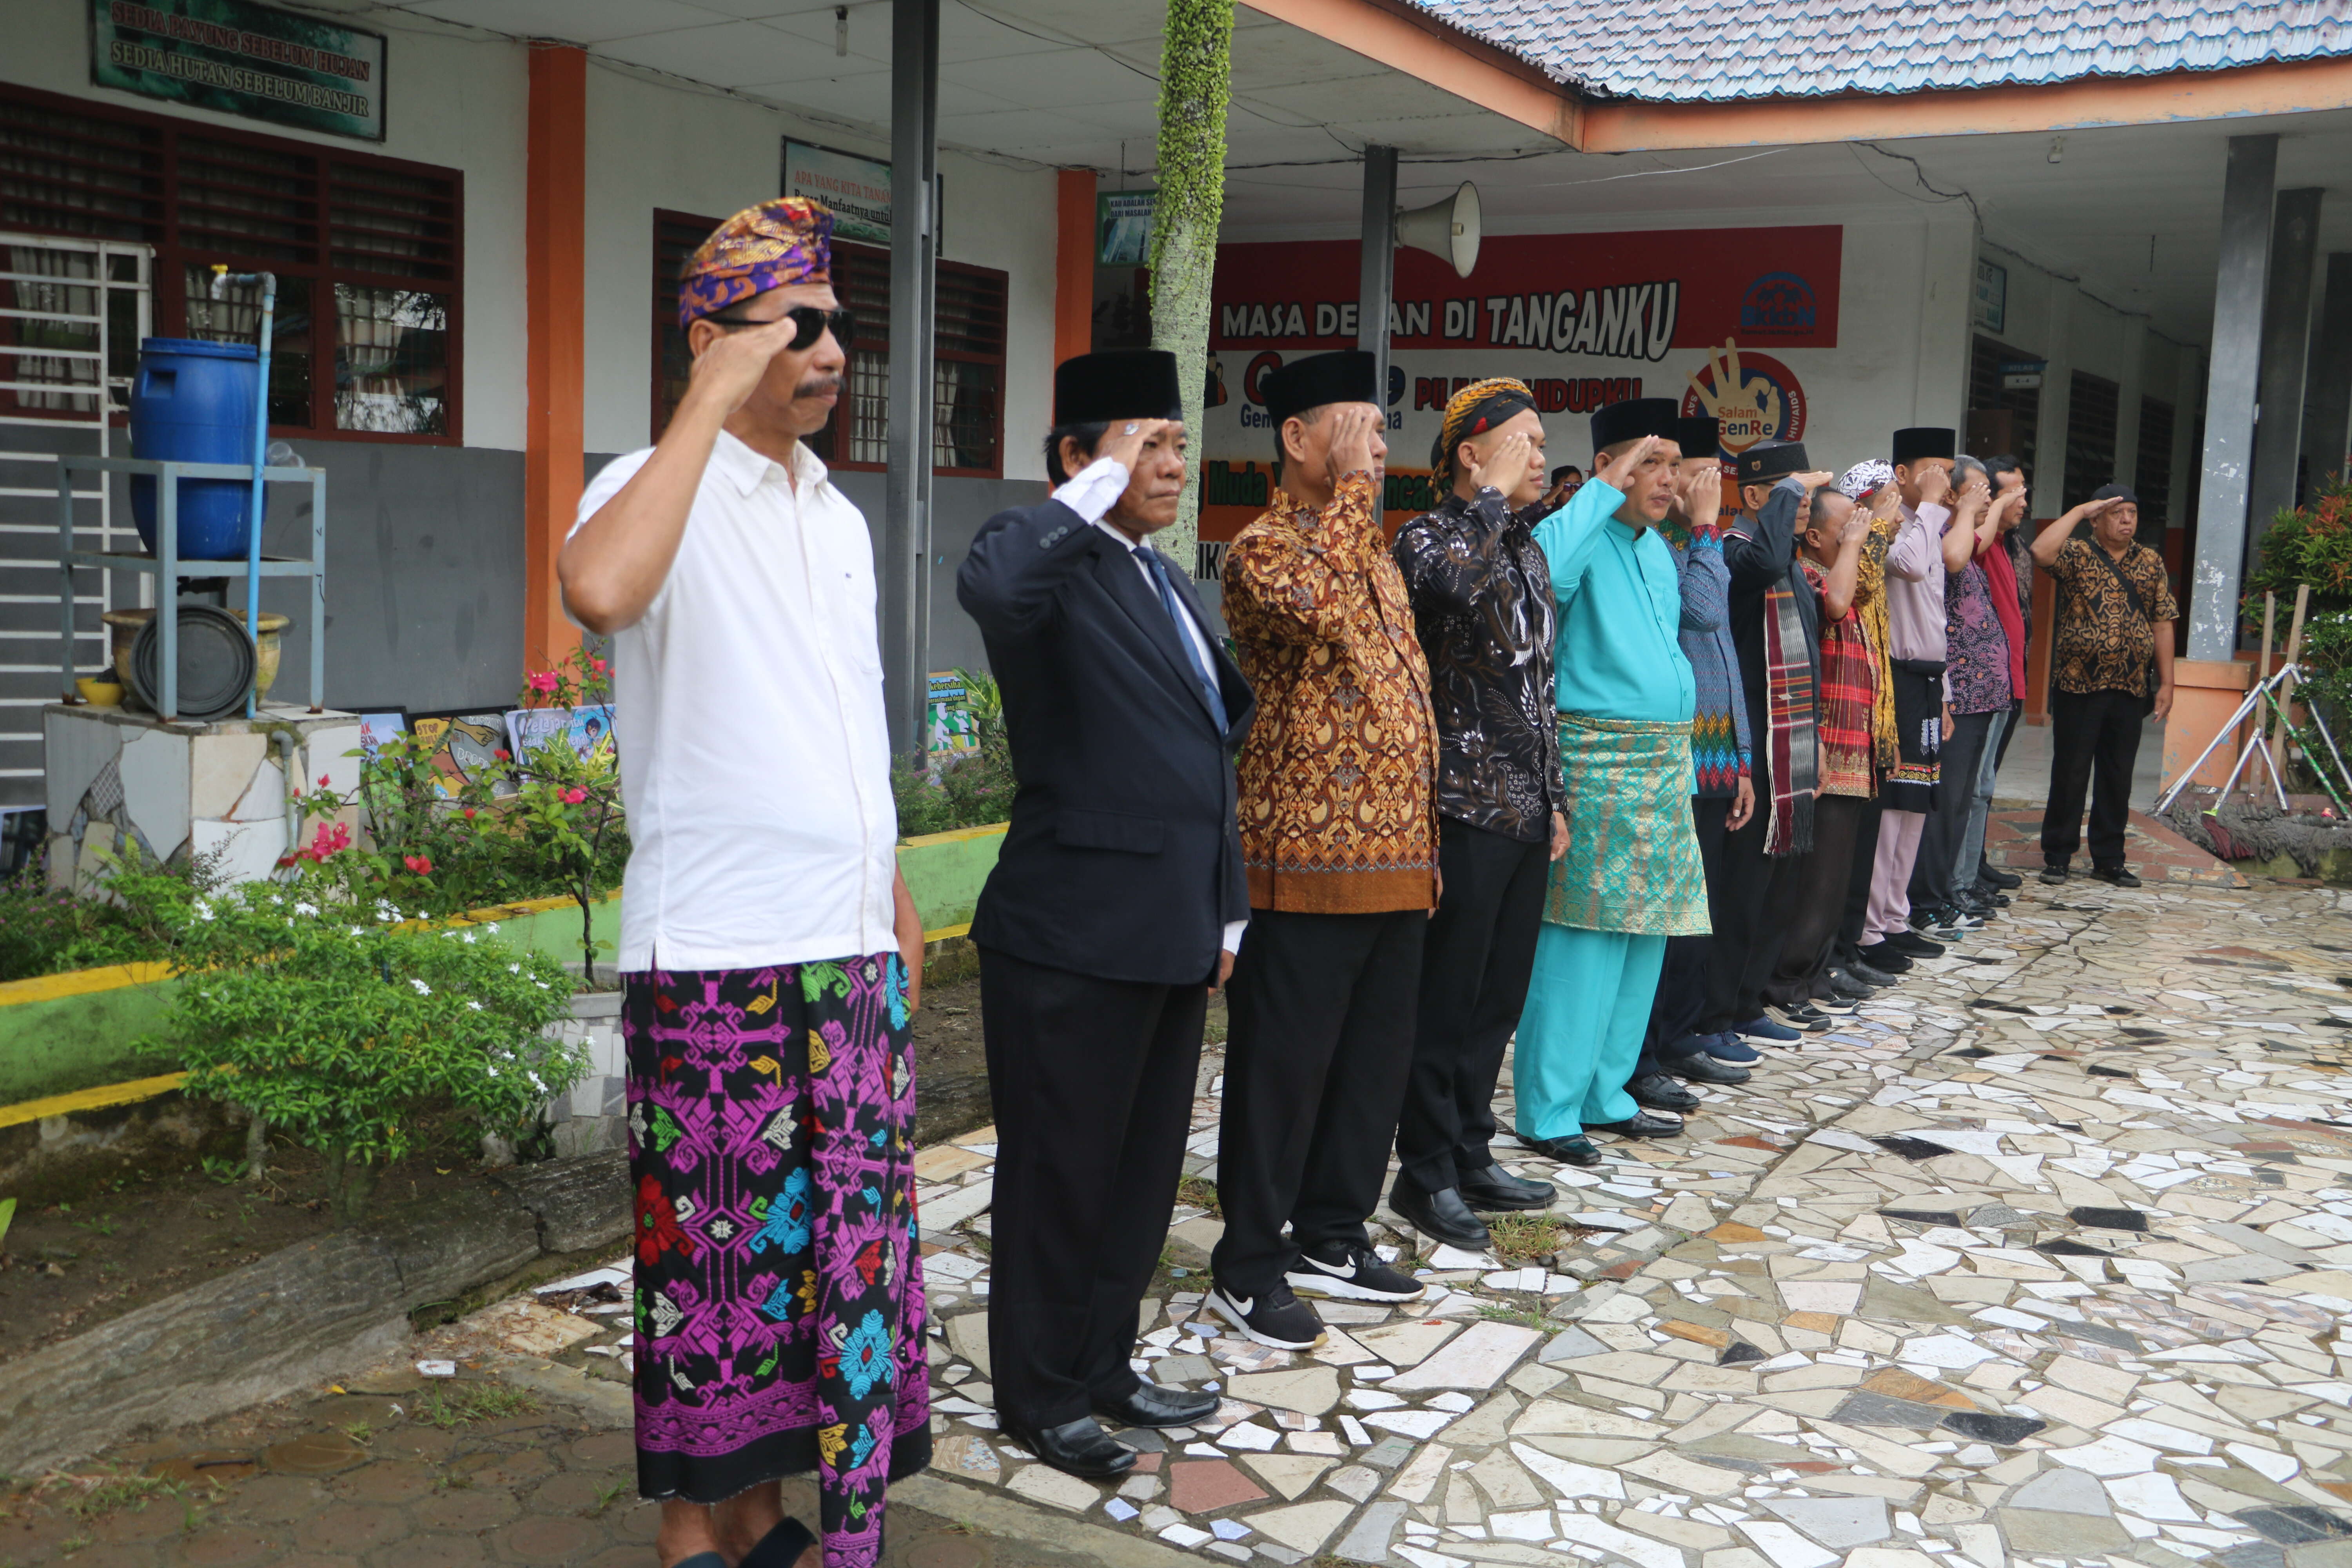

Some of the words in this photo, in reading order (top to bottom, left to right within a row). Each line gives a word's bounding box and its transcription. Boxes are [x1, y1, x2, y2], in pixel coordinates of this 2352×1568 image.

[112, 1, 167, 35] SEDIA
[169, 14, 239, 52] PAYUNG
[241, 32, 315, 69] SEBELUM
[317, 50, 370, 82] HUJAN
[112, 41, 168, 74] SEDIA
[168, 53, 232, 88] HUTAN
[234, 68, 310, 104] SEBELUM
[312, 85, 369, 117] BANJIR
[795, 170, 812, 185] APA
[815, 174, 838, 191] YANG
[840, 180, 861, 197] KITA
[820, 194, 868, 220] Manfaatnya
[1110, 209, 1124, 218] DARI
[1125, 209, 1152, 217] MASALAH
[1221, 302, 1307, 339] MASA
[1316, 300, 1432, 338] DEAN
[1443, 298, 1477, 341] DI
[1486, 279, 1680, 362] TANGANKU
[1523, 377, 1642, 413] HIDUPKU
[1687, 395, 1698, 416] SAY
[1718, 407, 1757, 418] Salam
[1788, 390, 1800, 438] HIV/AIDS
[1719, 420, 1773, 436] GenRe
[1208, 460, 1268, 507] Muda
[929, 679, 962, 691] kebersiha
[417, 723, 439, 735] STOP
